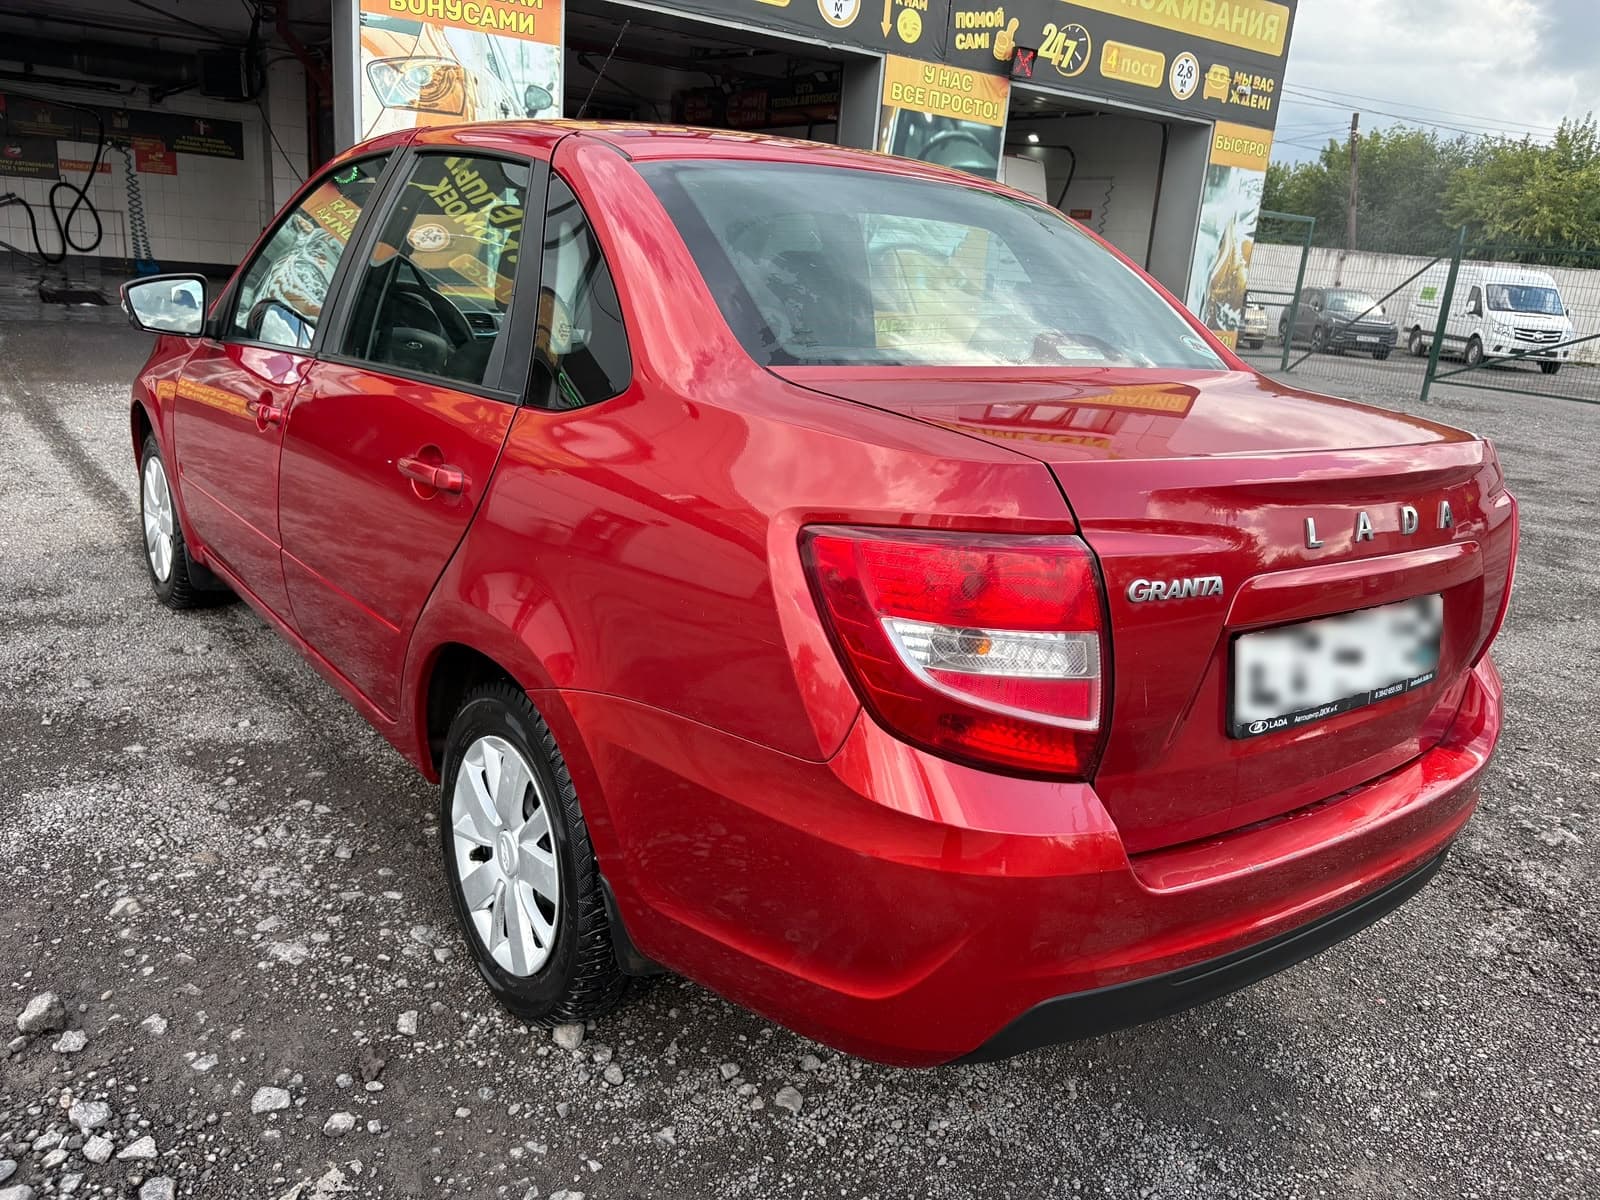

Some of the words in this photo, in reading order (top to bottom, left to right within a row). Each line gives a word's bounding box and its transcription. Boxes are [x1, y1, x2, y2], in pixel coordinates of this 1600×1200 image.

[955, 7, 1005, 29] ПОМОЙ
[1106, 48, 1120, 70] 4
[1121, 58, 1158, 78] ПОСТ
[1177, 63, 1194, 80] 2,8
[923, 64, 936, 84] У
[939, 69, 973, 92] НАС
[1233, 71, 1253, 87] МЫ
[1253, 75, 1275, 93] ВАС
[891, 81, 926, 106] ВСЕ
[928, 90, 999, 120] ПРОСТО!
[1215, 135, 1268, 157] БЫСТРО!
[1304, 501, 1455, 549] LADA
[1127, 576, 1224, 603] GRANTA
[1269, 718, 1288, 729] LADA
